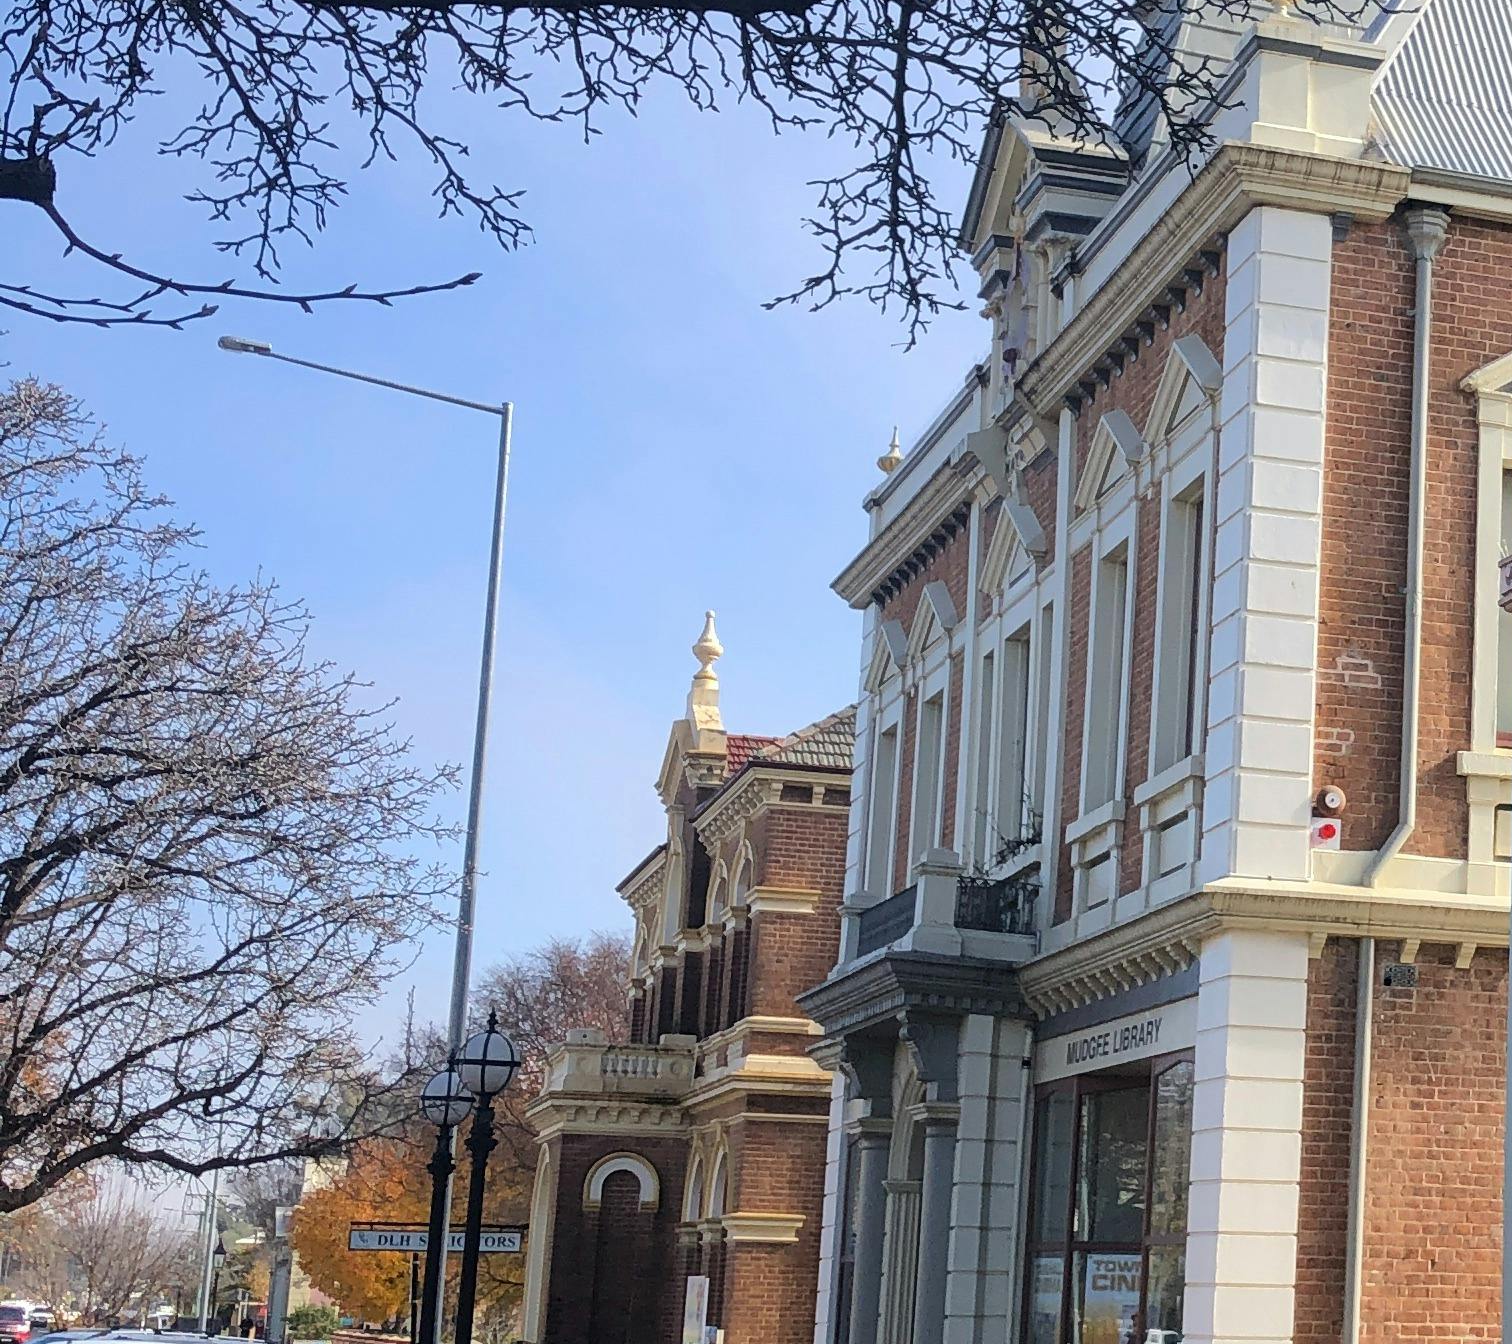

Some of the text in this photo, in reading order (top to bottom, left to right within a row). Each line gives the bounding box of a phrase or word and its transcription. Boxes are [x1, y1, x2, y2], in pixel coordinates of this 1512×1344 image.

[1066, 1017, 1163, 1065] MUDGEE LIBRARY
[377, 1234, 516, 1248] DLH SICORS
[1091, 1274, 1142, 1292] CIN
